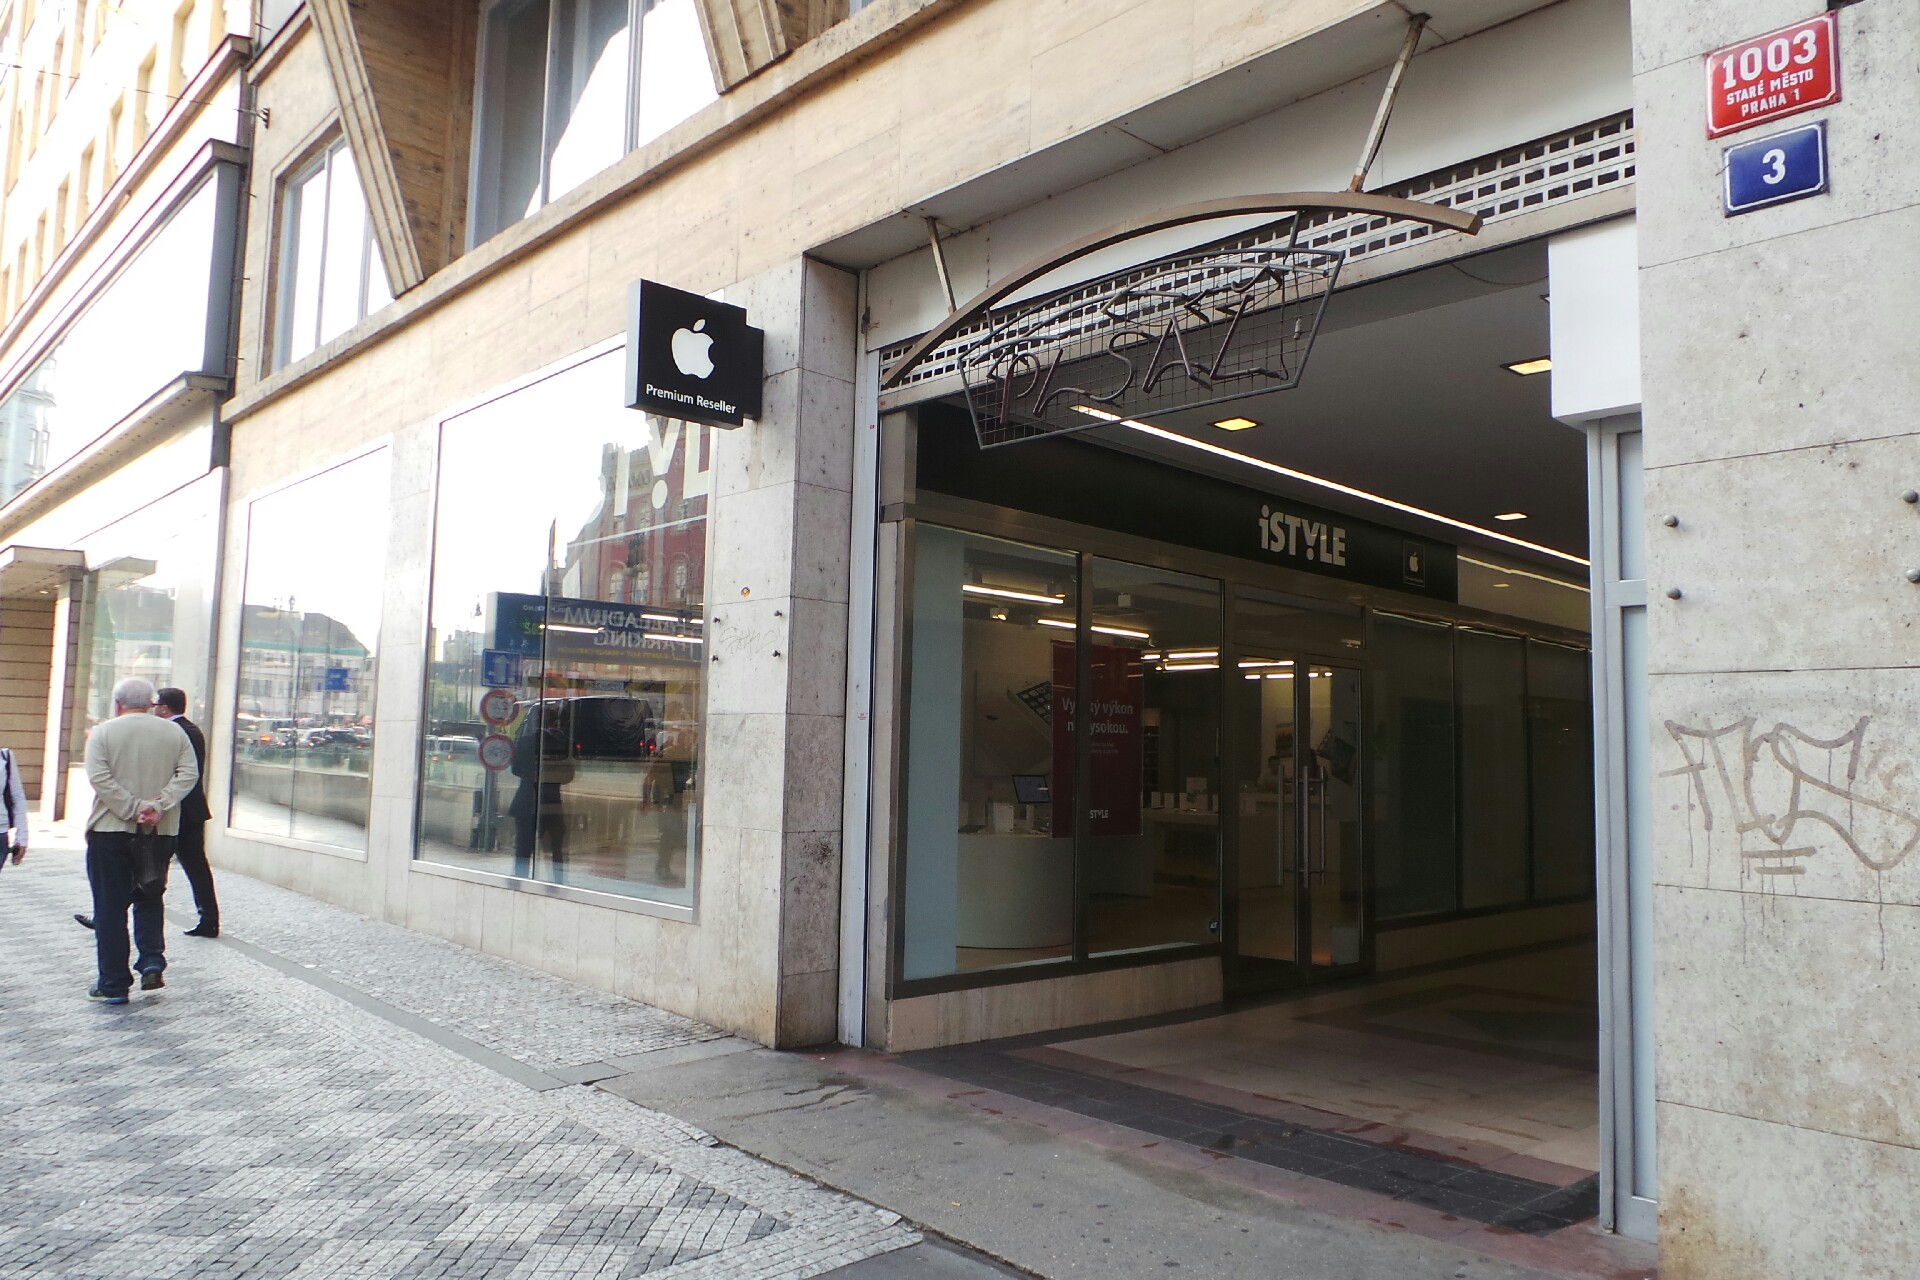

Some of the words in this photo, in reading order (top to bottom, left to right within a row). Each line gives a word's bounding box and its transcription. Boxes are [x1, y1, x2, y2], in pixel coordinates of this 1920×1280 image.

[1722, 29, 1817, 90] 1003
[1727, 80, 1765, 105] STARÉ
[1770, 68, 1814, 92] MĚSTO
[1741, 93, 1788, 117] PRAHA
[1791, 88, 1801, 101] 1
[1762, 149, 1786, 184] 3
[645, 383, 694, 405] Premium
[696, 395, 737, 414] Reseller
[1259, 504, 1346, 567] iSTYLE
[1103, 700, 1134, 717] výkon
